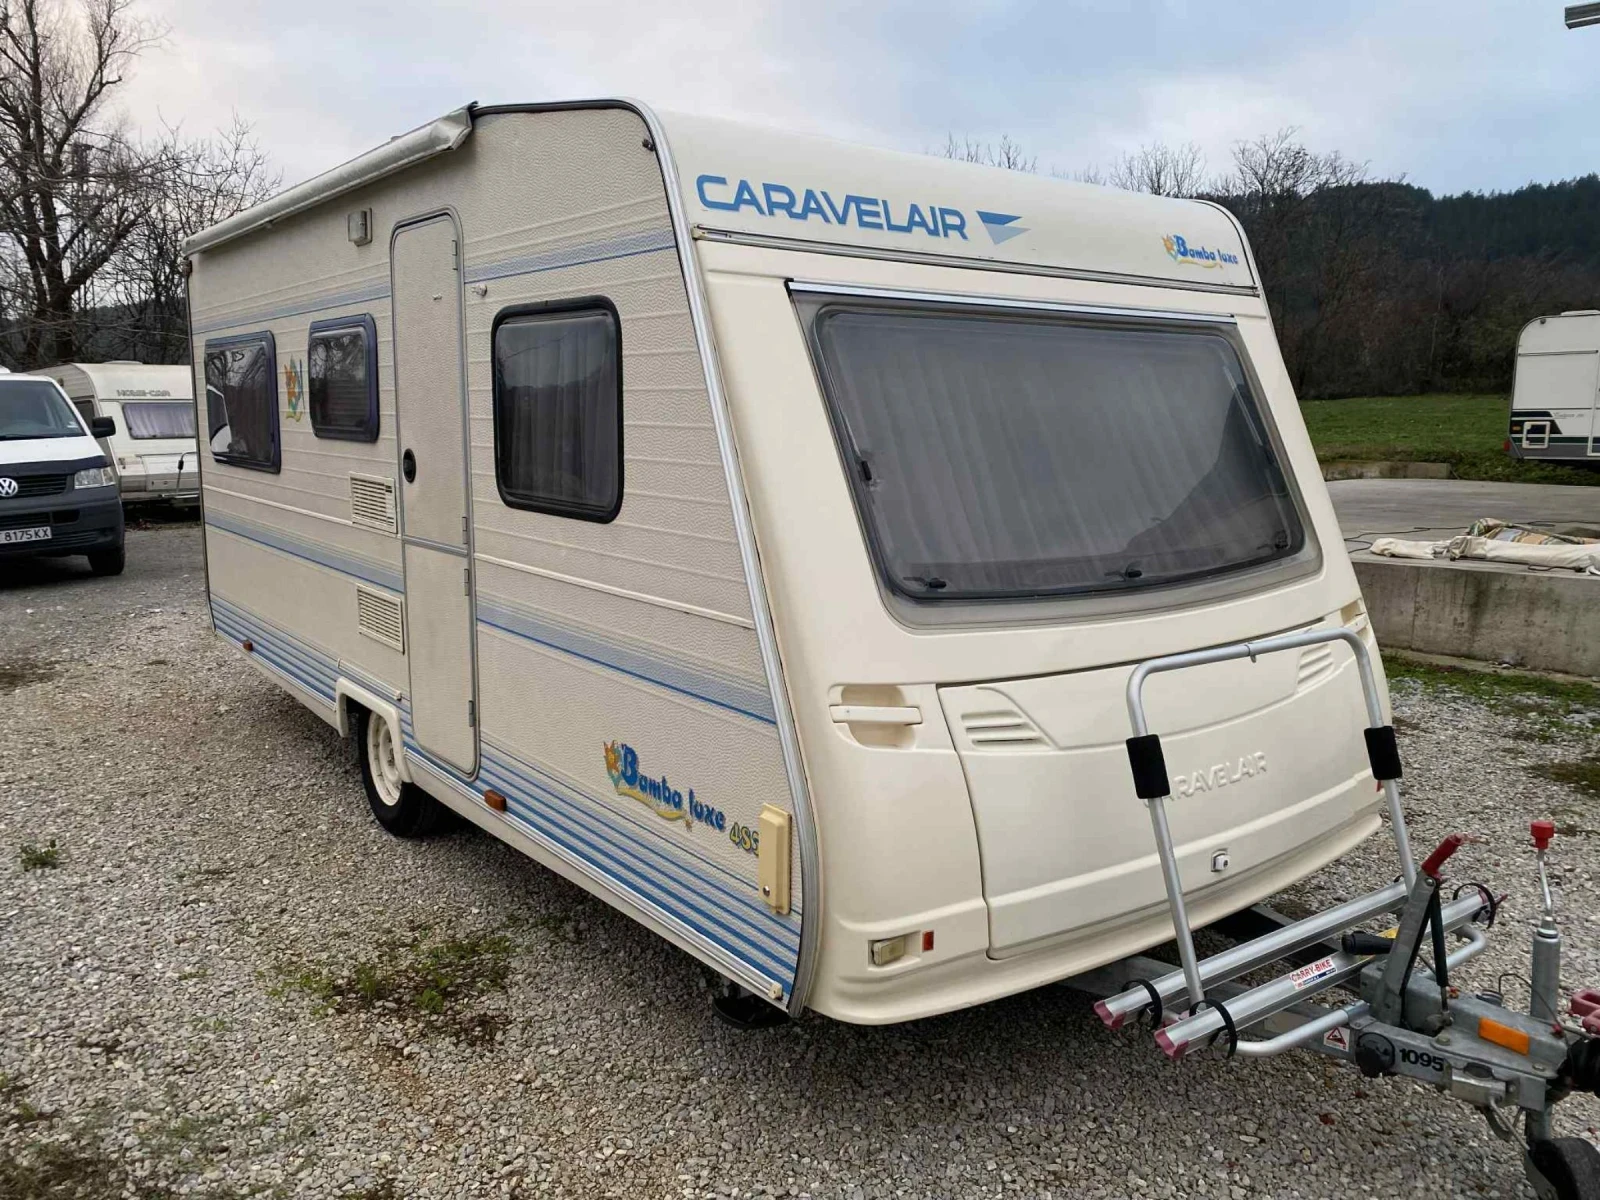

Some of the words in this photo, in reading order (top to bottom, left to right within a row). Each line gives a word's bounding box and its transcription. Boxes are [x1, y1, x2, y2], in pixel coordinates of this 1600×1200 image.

[696, 174, 969, 241] CARAVELAIR
[621, 743, 683, 810] Bamba
[689, 788, 726, 832] luxe
[1145, 751, 1268, 807] RAVELAIR
[1399, 1047, 1445, 1073] 1095
